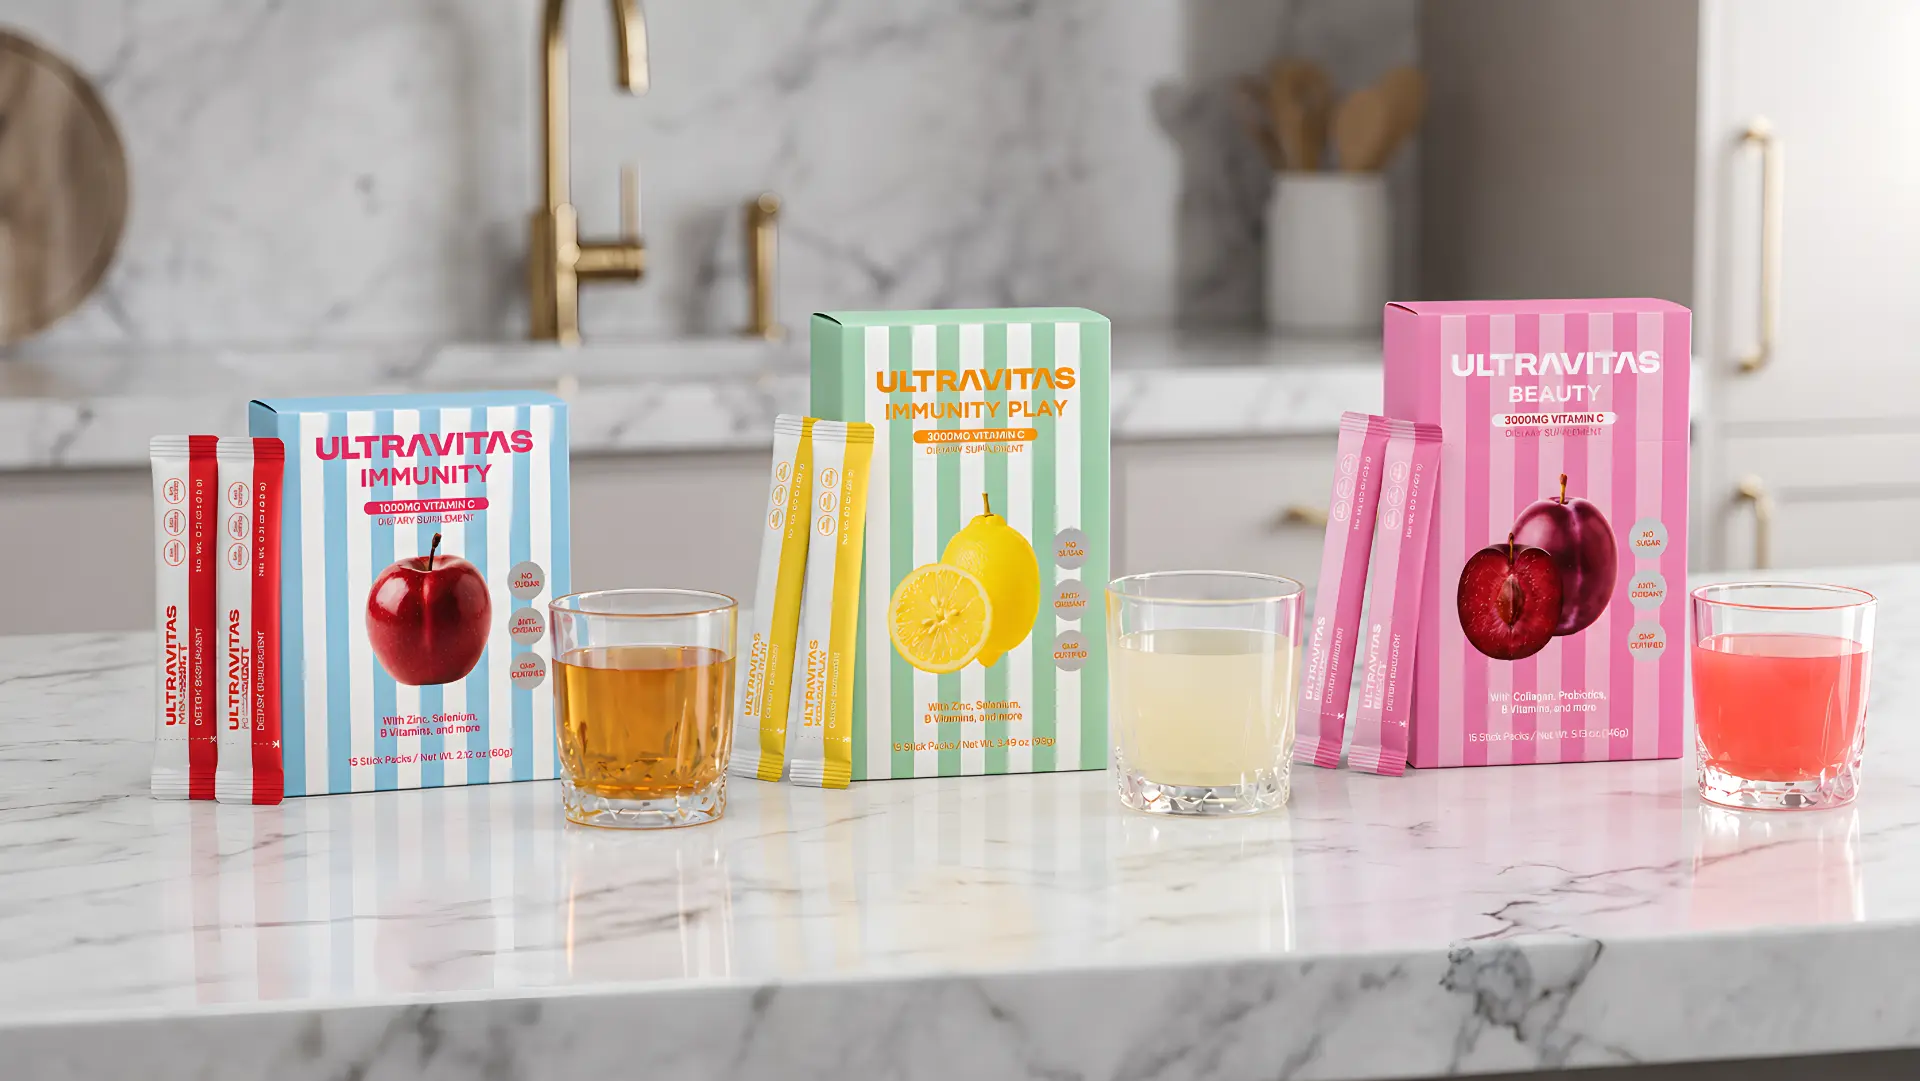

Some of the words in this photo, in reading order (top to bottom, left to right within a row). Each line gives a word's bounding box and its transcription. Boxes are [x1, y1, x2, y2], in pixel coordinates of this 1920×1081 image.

[1451, 351, 1661, 377] ULTRAVITAS
[876, 367, 1075, 393] ULTRAVITAS
[1509, 384, 1601, 403] BEAUTY
[885, 401, 1001, 420] IMMUNITY
[1008, 400, 1068, 417] PLAY
[1505, 415, 1549, 424] 3000MG
[1551, 414, 1594, 424] VITAMIN
[1597, 414, 1604, 422] C
[316, 430, 533, 460] ULTRAVITAS
[973, 431, 1016, 440] VITAMIN
[1018, 431, 1024, 439] C
[361, 464, 492, 487] IMMUNITY
[379, 503, 420, 513] 1000MG
[423, 501, 466, 511] VITAMIN
[468, 500, 475, 509] C
[165, 605, 177, 726] ULTRAVITAS
[228, 609, 240, 730] ULTRAVITAS
[1364, 624, 1382, 709] ULTRAVITAS
[804, 640, 818, 727] ULTRAVITAS
[980, 712, 996, 721] and
[999, 712, 1022, 720] more
[1554, 704, 1570, 712] and
[383, 715, 404, 725] With
[436, 725, 453, 734] and
[456, 725, 480, 733] more
[348, 758, 358, 766] 15
[360, 756, 382, 765] Stick
[385, 755, 411, 763] Packs
